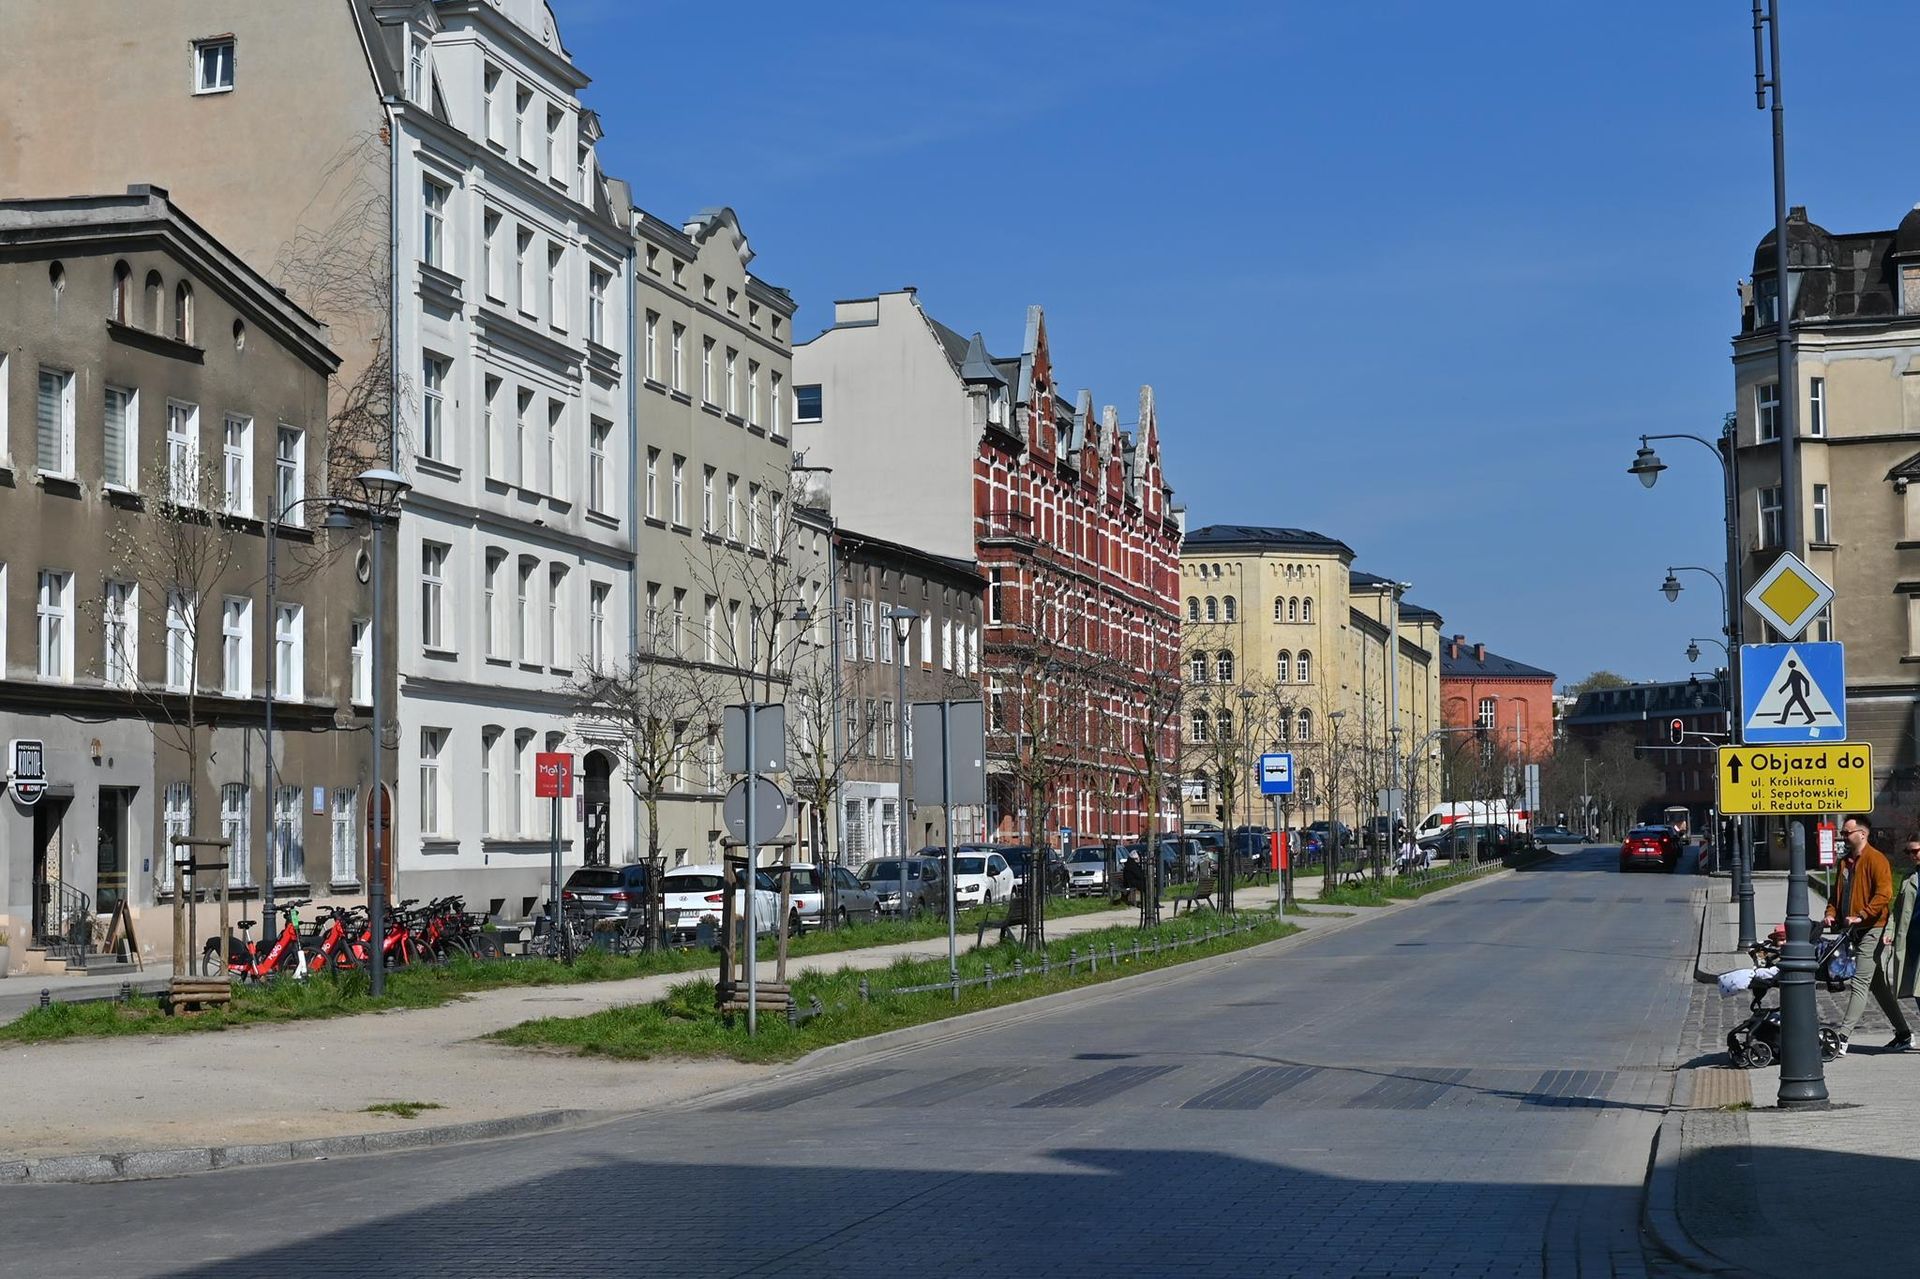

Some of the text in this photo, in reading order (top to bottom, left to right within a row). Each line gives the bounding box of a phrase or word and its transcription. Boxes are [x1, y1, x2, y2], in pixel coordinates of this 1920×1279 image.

[1751, 752, 1865, 775] Objazd do
[1751, 775, 1835, 787] ul. Królikarnia
[1751, 787, 1848, 801] ul. Sępołowskiej
[1751, 799, 1843, 811] ul. Reduta Dzik
